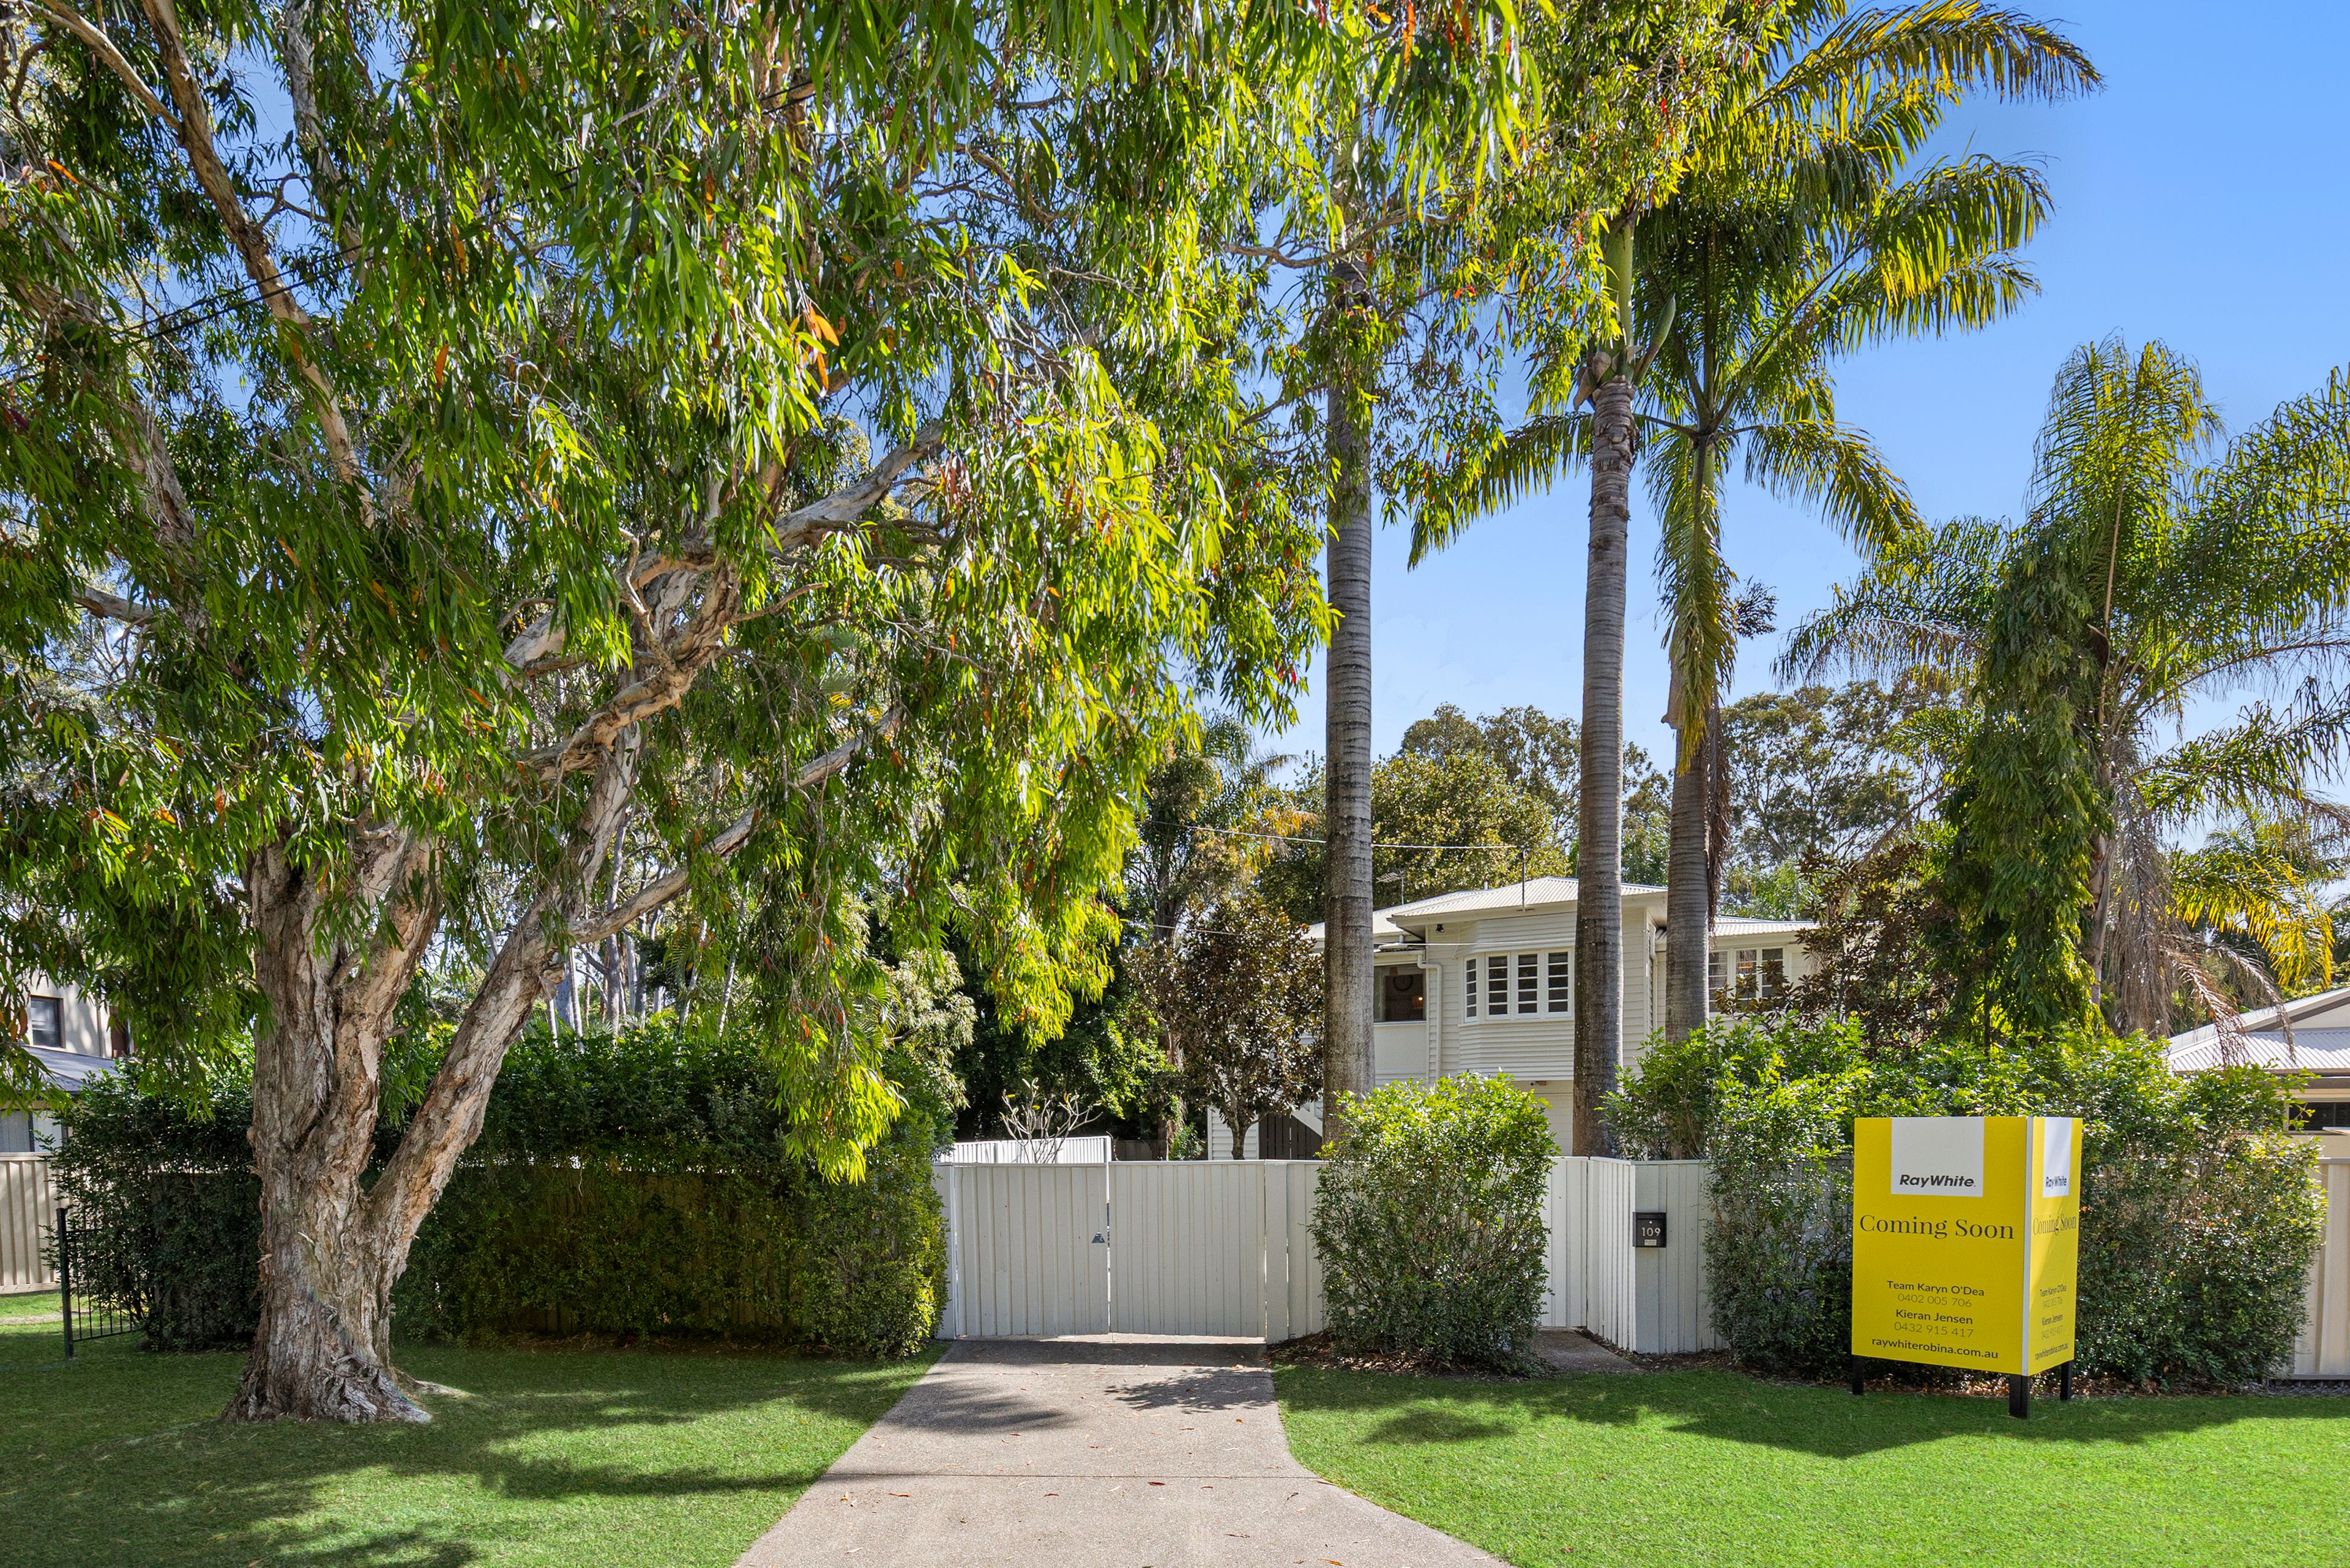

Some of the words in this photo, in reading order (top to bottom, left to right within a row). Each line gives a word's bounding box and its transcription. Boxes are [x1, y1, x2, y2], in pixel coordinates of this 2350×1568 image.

[1641, 1227, 1661, 1237] 109
[1860, 1215, 1947, 1239] Coming
[1955, 1219, 2015, 1239] Soon
[2033, 1214, 2059, 1236] Coming
[2061, 1214, 2076, 1231] Soon
[1887, 1280, 1914, 1291] Team
[1917, 1283, 1947, 1294] Karyn
[1951, 1285, 1985, 1296] O'Dea
[1898, 1293, 1924, 1304] 0402
[1928, 1296, 1948, 1305] 005
[1952, 1297, 1972, 1307] 706
[1896, 1309, 1931, 1321] Kieran
[1934, 1313, 1973, 1324] Jensen
[1894, 1321, 1922, 1333] 0432
[1926, 1325, 1948, 1335] 915
[1951, 1326, 1974, 1338] 417
[1872, 1338, 1998, 1359] raywhiterobina.com.au
